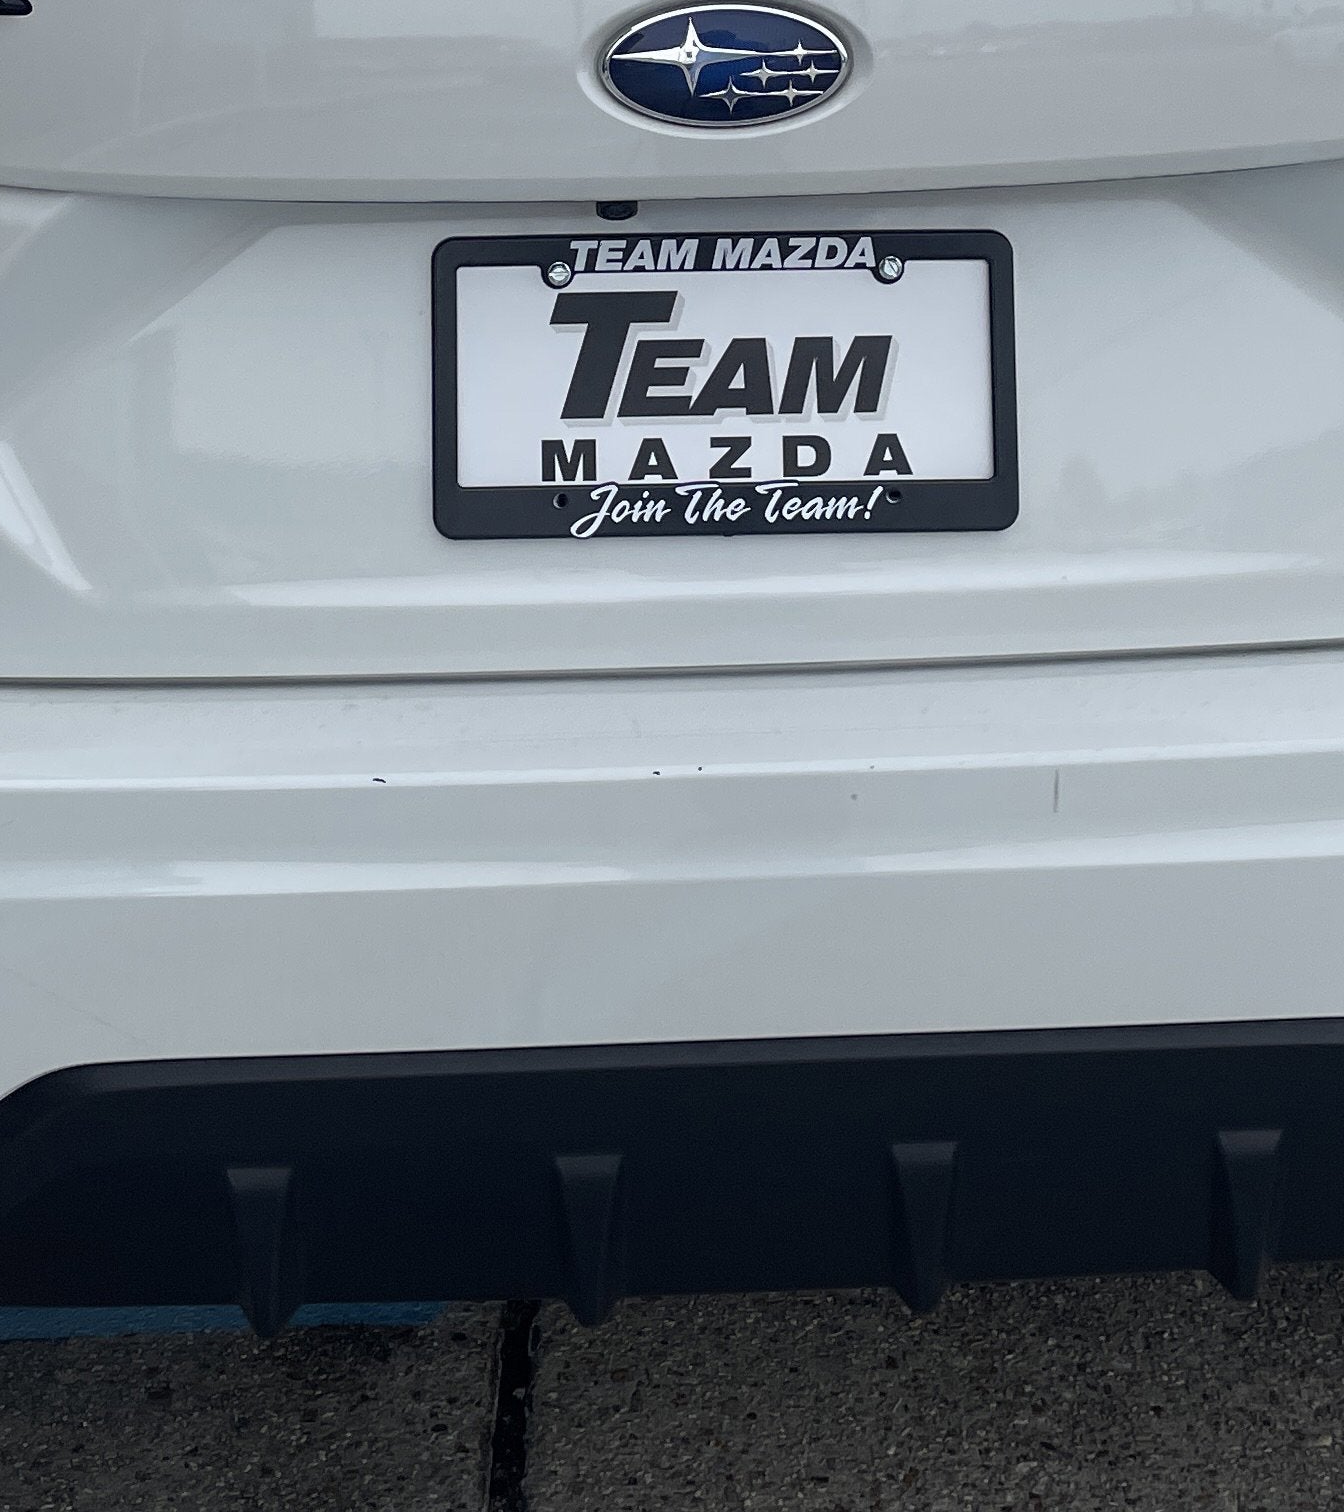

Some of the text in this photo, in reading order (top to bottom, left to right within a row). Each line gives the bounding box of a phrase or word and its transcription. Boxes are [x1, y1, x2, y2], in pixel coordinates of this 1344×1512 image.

[569, 235, 877, 272] TEAM MAZDA
[548, 289, 897, 424] TEAM
[540, 432, 914, 483] MAZDA
[569, 482, 885, 538] Join The Team!
